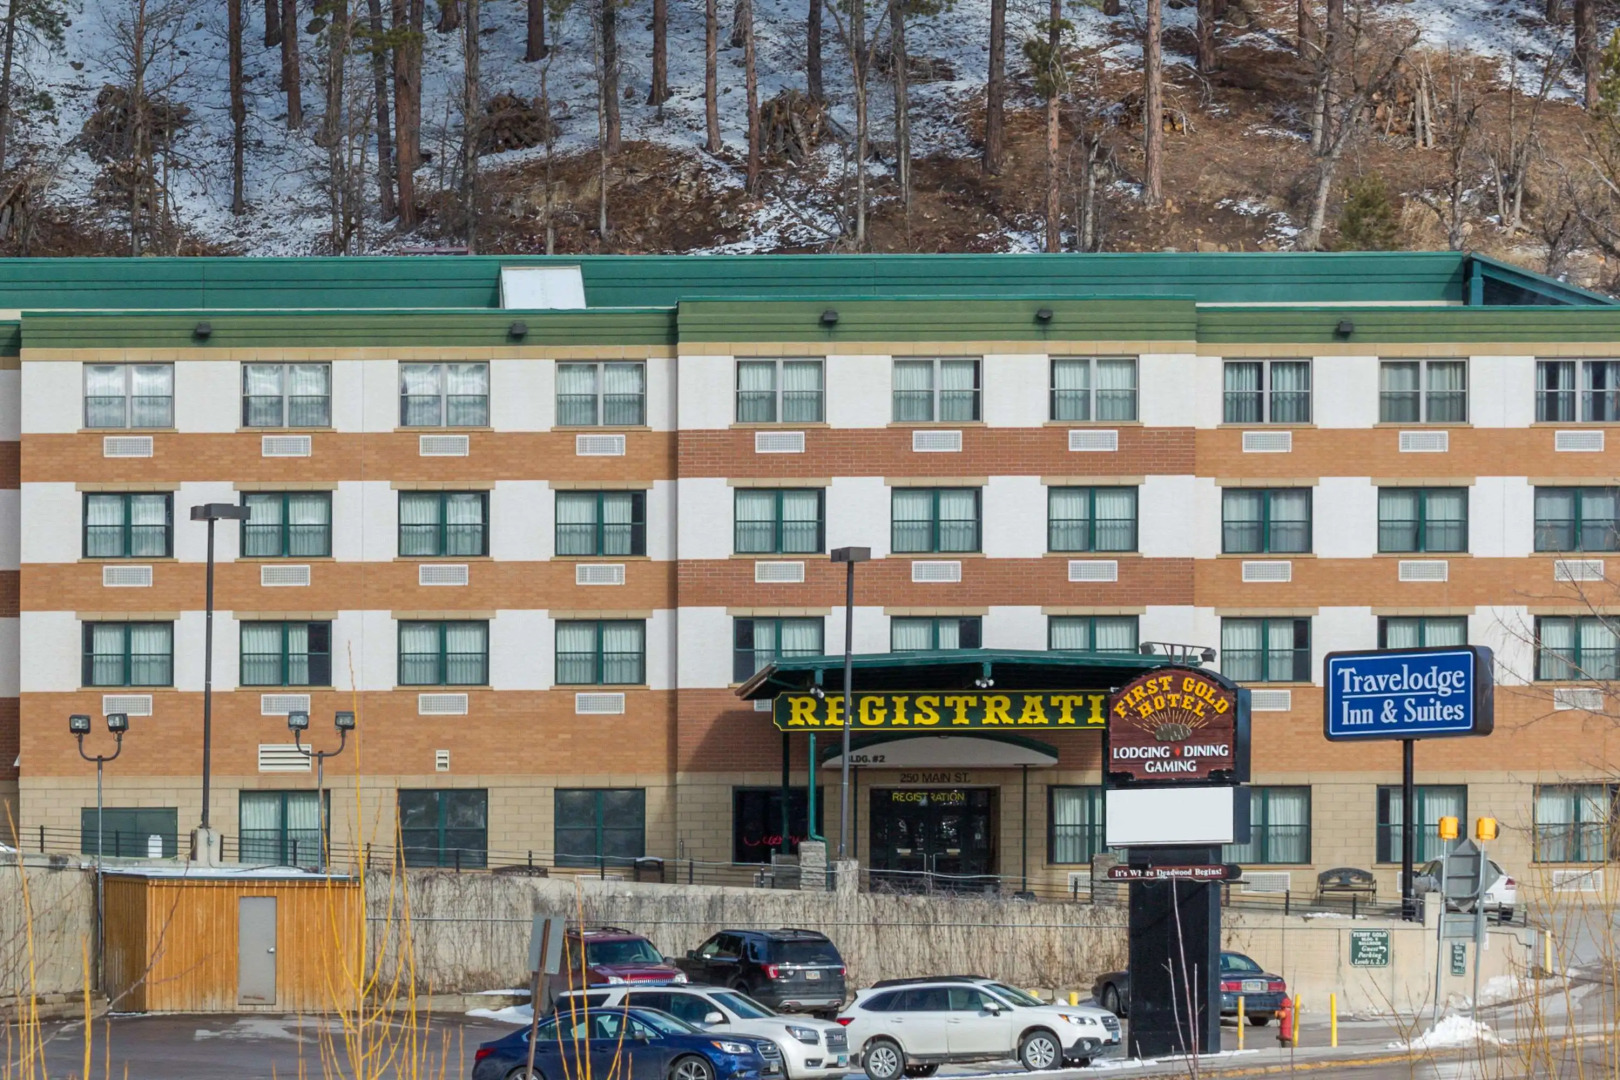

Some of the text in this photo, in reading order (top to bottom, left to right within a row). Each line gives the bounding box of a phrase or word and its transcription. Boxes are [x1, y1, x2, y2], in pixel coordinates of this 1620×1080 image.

[1337, 664, 1465, 697] Travelodge
[1114, 675, 1229, 719] FIRST GOLD
[787, 694, 1105, 726] REGISTRATI
[1137, 693, 1205, 719] HOTEL
[1342, 698, 1465, 725] Inn & Suites
[849, 755, 886, 763] LDG. #2
[1113, 744, 1229, 759] LODGING DINING
[1145, 760, 1196, 773] GAMING
[900, 772, 971, 783] 250 MAIN ST.
[892, 792, 965, 802] REGISTRATION
[1114, 867, 1222, 877] It's Wre Deadwood Begins!
